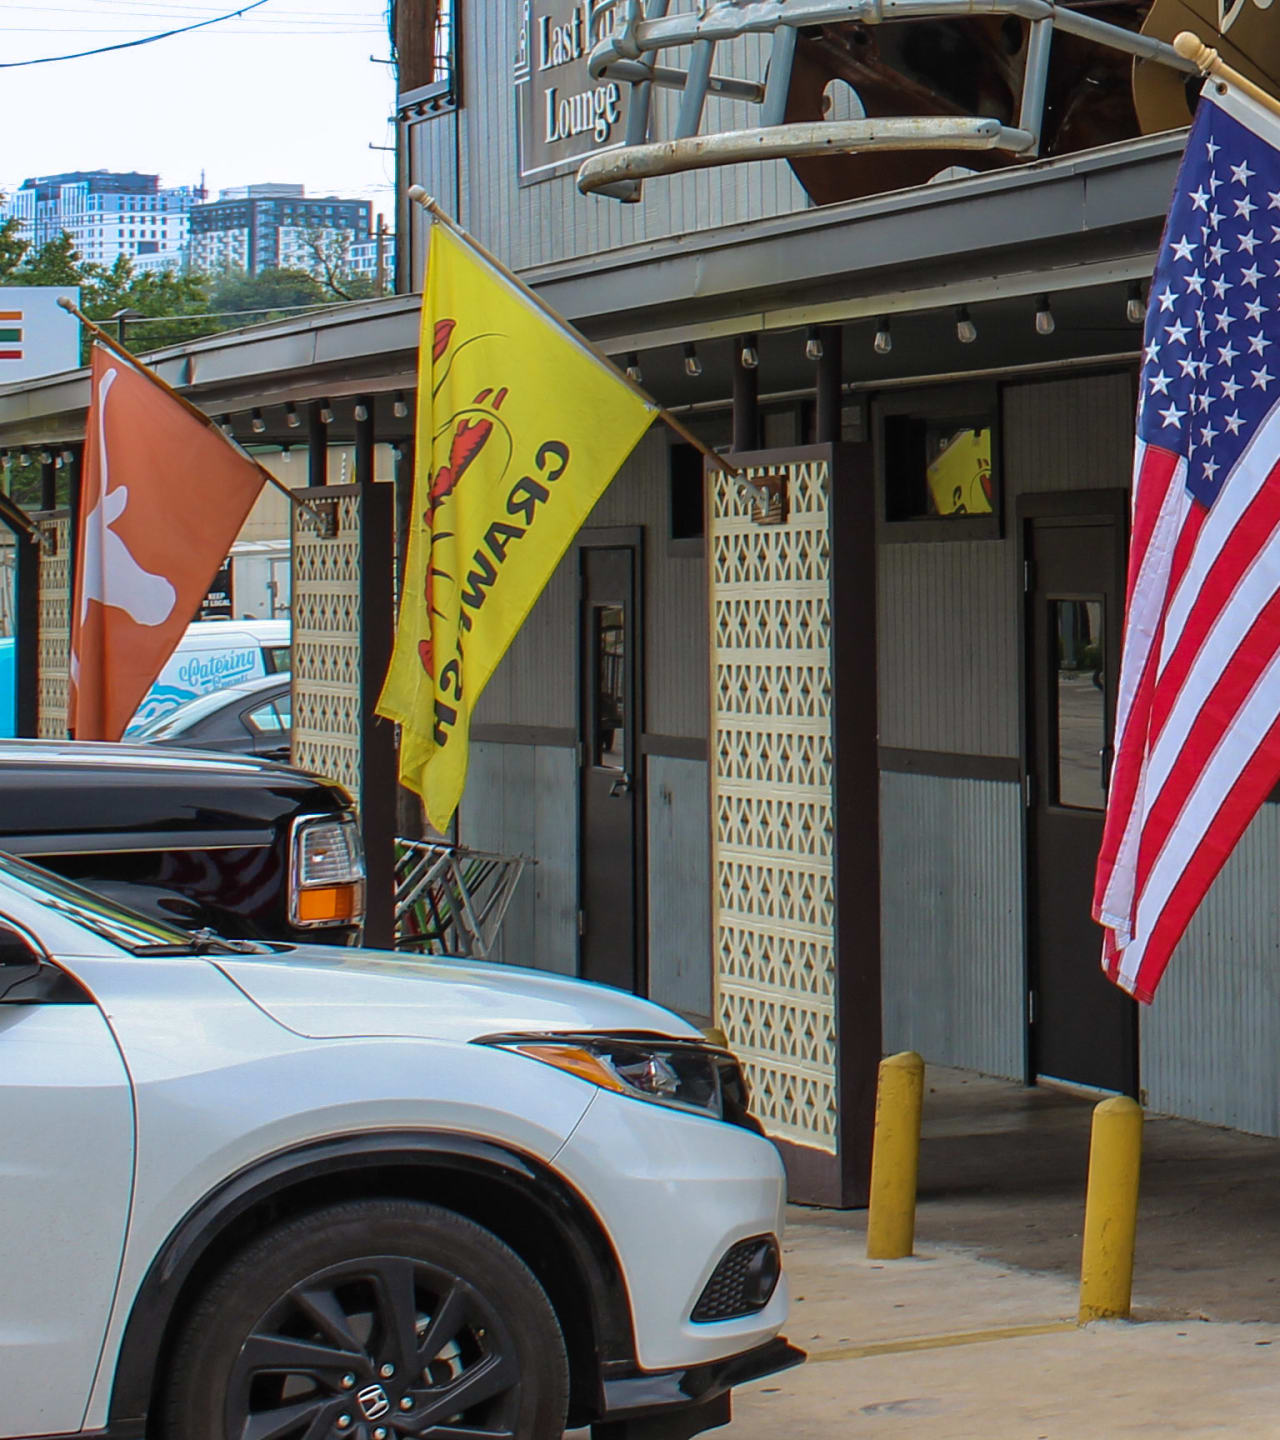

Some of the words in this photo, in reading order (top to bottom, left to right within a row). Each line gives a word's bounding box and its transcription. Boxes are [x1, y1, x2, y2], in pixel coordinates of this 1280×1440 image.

[538, 7, 582, 72] Last
[544, 82, 620, 144] Lounge
[178, 649, 256, 687] Catering
